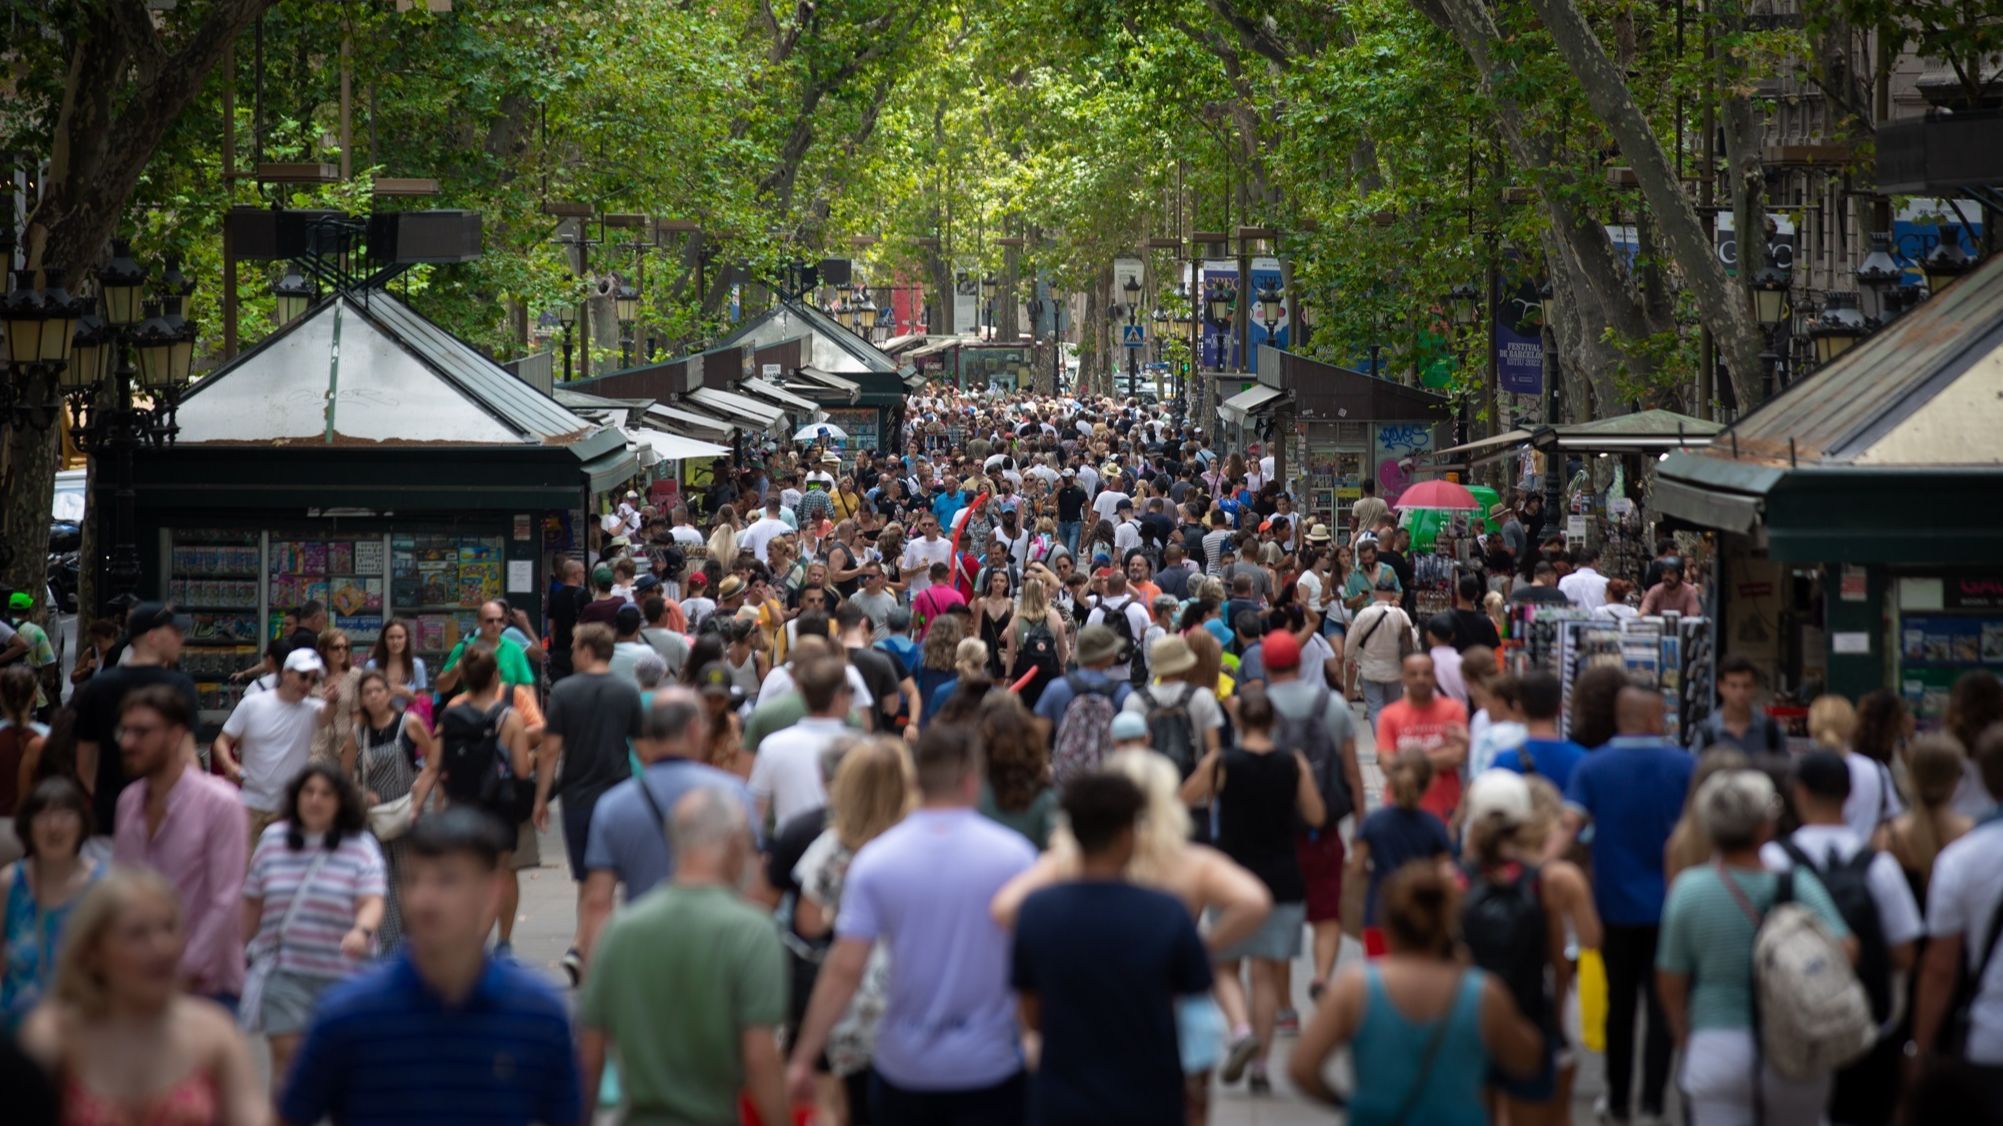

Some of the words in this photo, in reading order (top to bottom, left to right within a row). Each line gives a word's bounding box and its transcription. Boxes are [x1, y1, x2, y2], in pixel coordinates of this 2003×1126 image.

[1718, 240, 1792, 268] GC
[1507, 342, 1541, 352] FESTIVAL
[1499, 349, 1507, 358] DE
[1506, 357, 1524, 367] ESTIU
[1525, 358, 1541, 367] 2022
